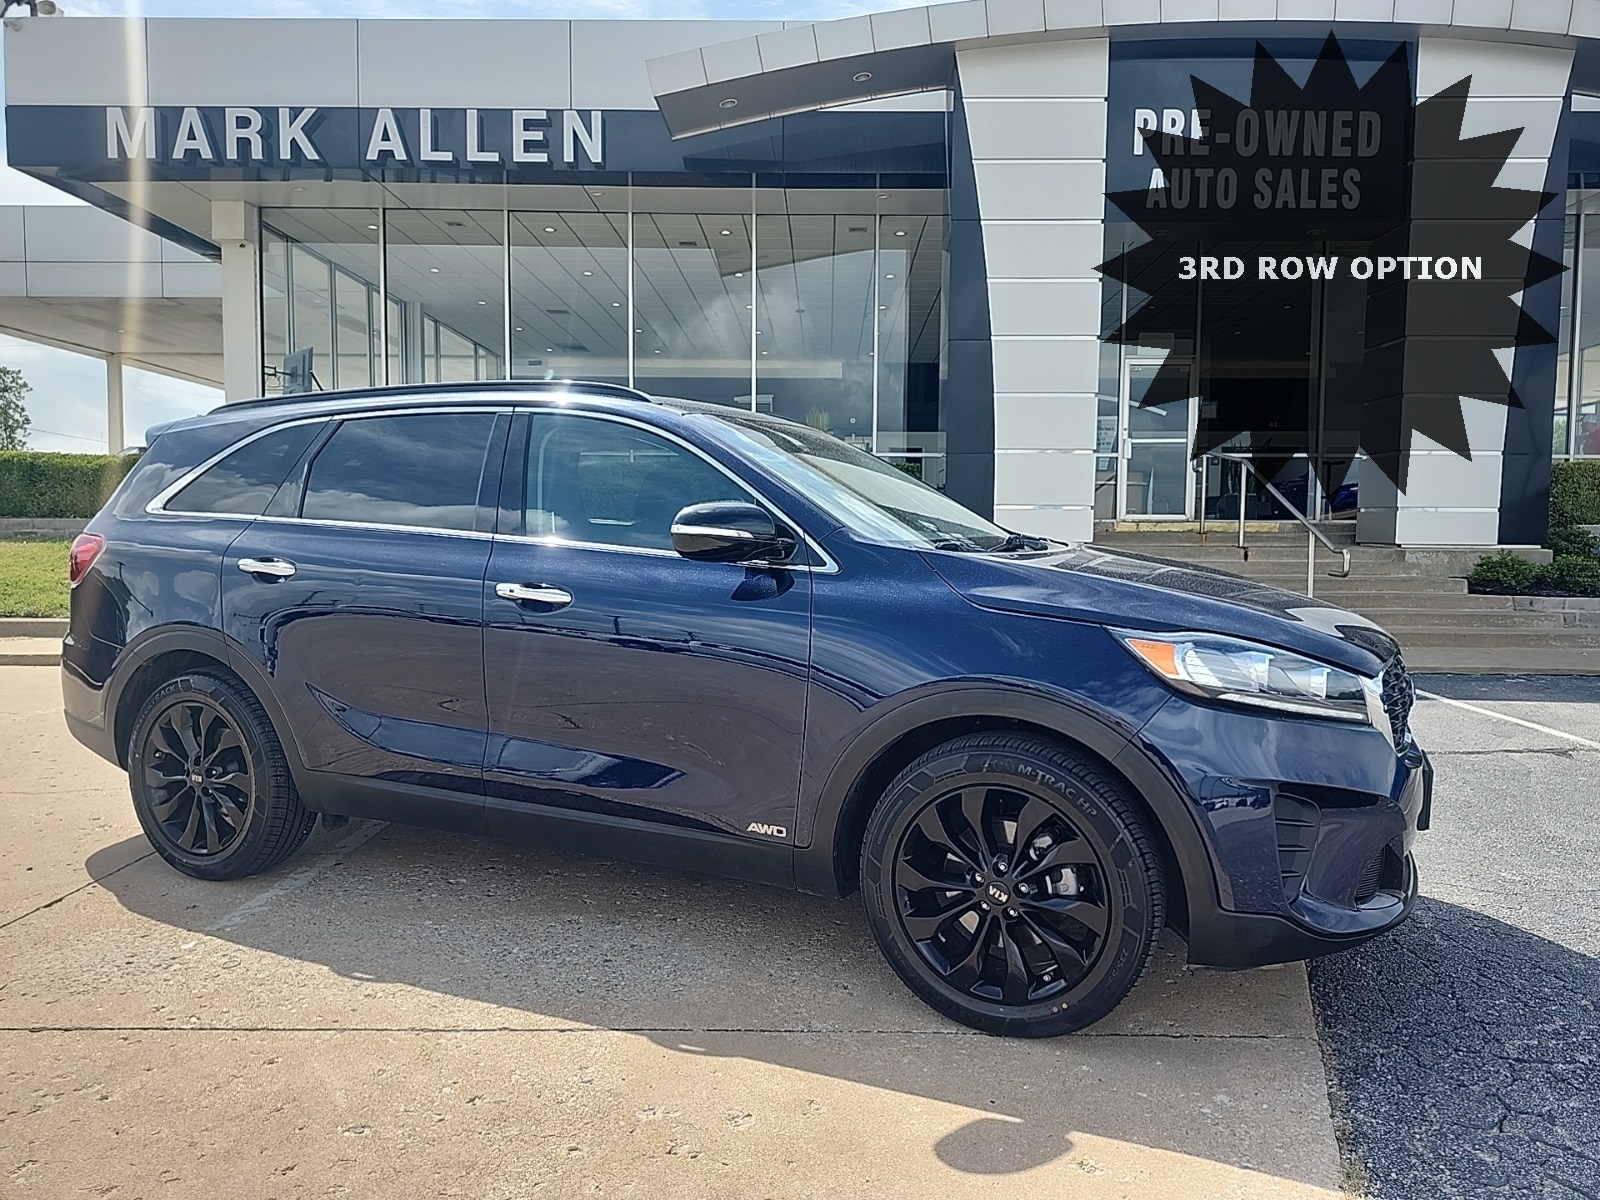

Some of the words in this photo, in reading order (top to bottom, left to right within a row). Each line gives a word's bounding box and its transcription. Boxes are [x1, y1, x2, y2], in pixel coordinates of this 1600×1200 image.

[106, 107, 320, 161] MARK
[365, 107, 603, 163] ALLEN
[1132, 107, 1382, 159] PRE-OWNED
[1145, 167, 1239, 210] AUTO
[1253, 166, 1362, 211] SALES
[1018, 763, 1077, 799] M-TRAC
[1076, 797, 1098, 816] HP
[746, 822, 788, 838] AWD
[989, 885, 1008, 903] KIA
